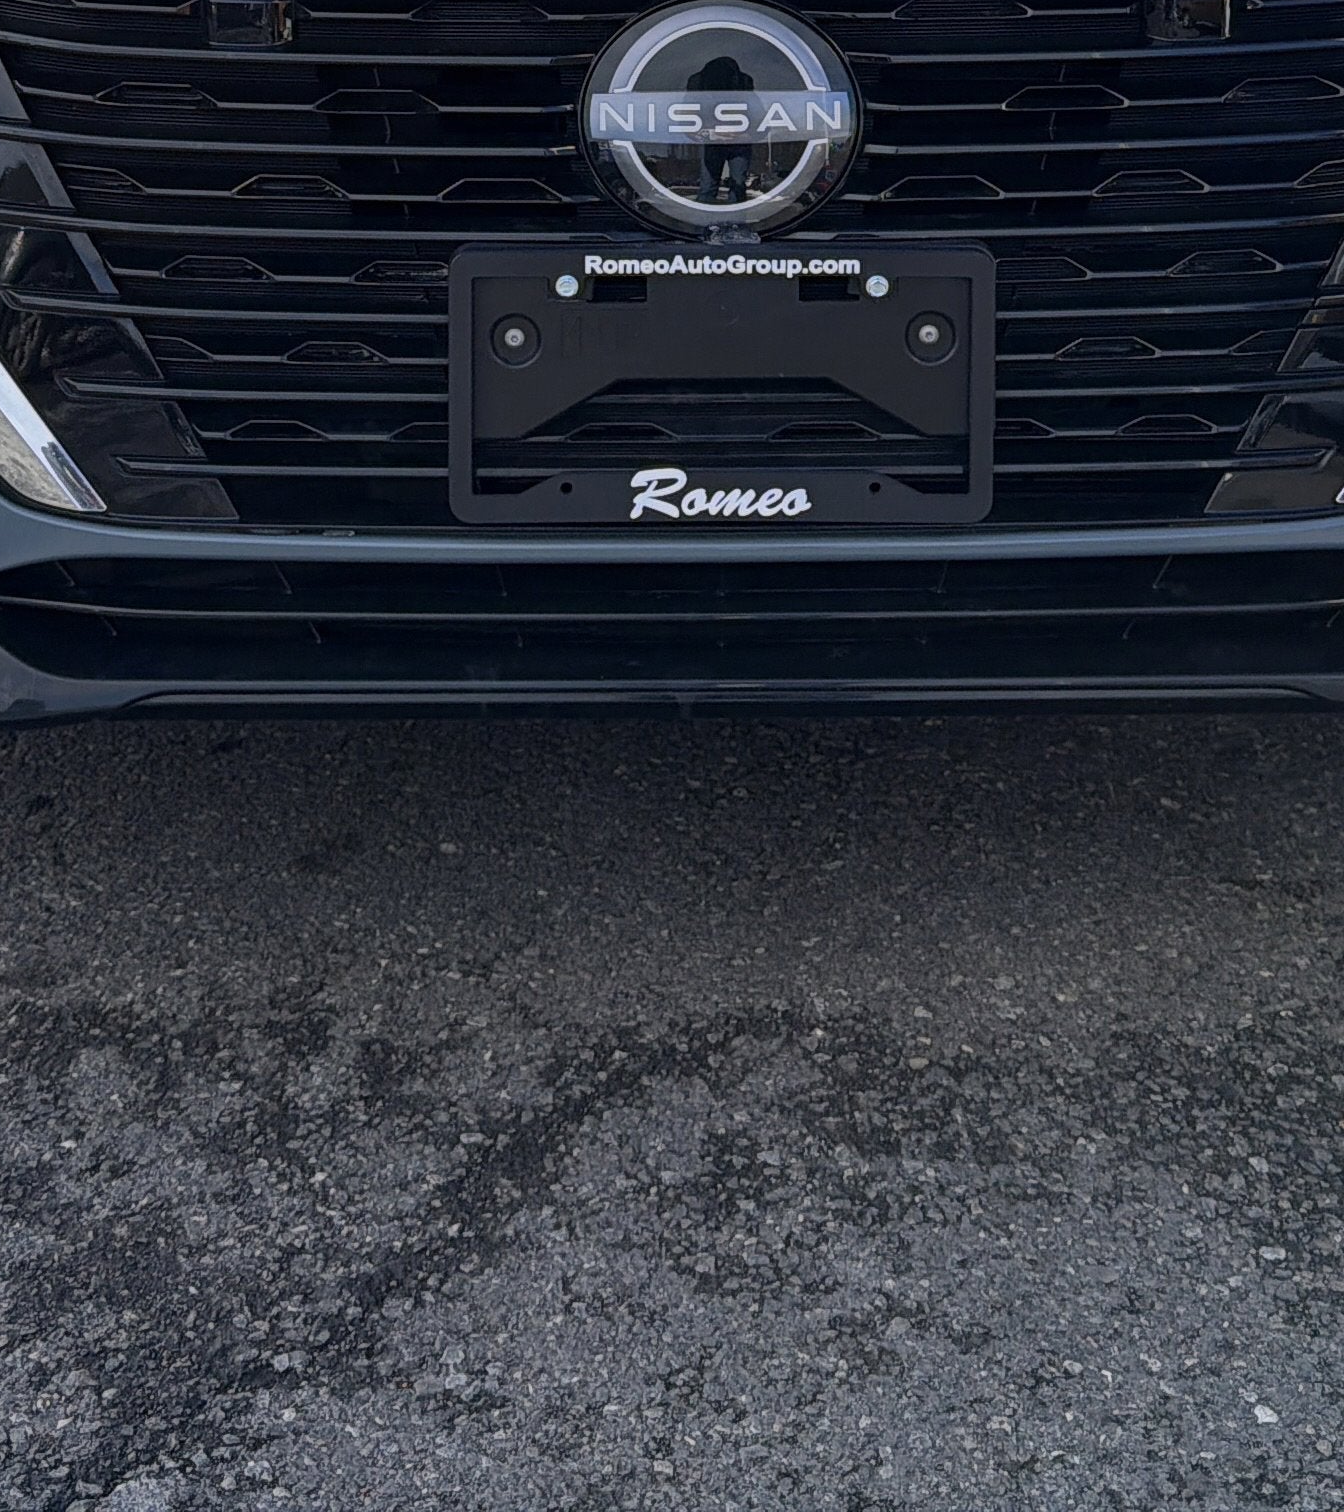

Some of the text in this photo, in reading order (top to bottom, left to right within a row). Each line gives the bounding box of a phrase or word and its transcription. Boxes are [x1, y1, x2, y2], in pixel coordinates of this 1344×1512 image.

[599, 100, 841, 133] NISSAN
[584, 255, 861, 278] RomeoAutoGroup.com
[630, 468, 812, 519] Romeo
